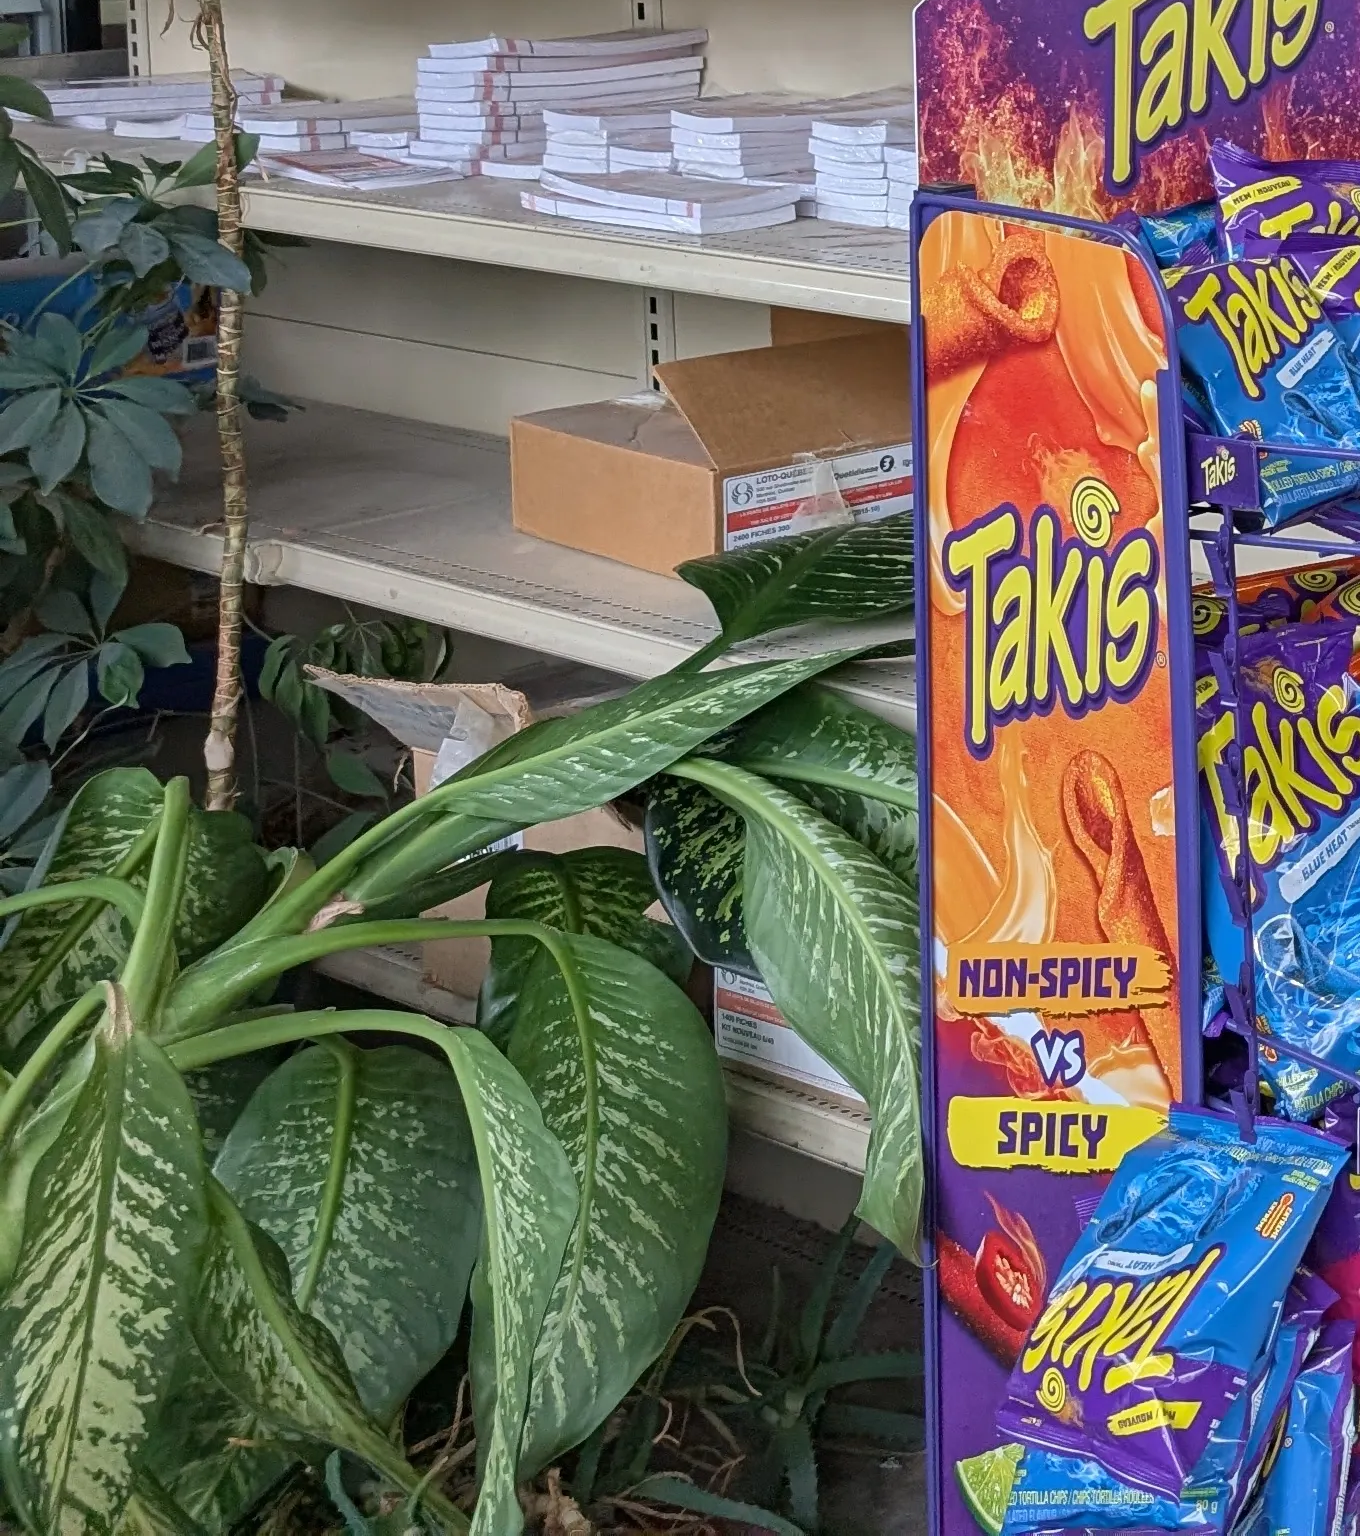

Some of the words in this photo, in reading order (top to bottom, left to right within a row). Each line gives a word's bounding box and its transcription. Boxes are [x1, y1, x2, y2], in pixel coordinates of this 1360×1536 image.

[1257, 180, 1293, 197] NOUVEAU
[1184, 258, 1322, 398] Takis
[1201, 446, 1237, 496] Takis
[949, 476, 1151, 745] Takis
[1301, 848, 1328, 882] BLUE
[1325, 830, 1350, 858] HEAT
[959, 956, 1138, 1000] NON-SPICY
[1034, 1032, 1083, 1083] VS
[997, 1111, 1109, 1159] SPICY
[1022, 1252, 1218, 1411] Takis
